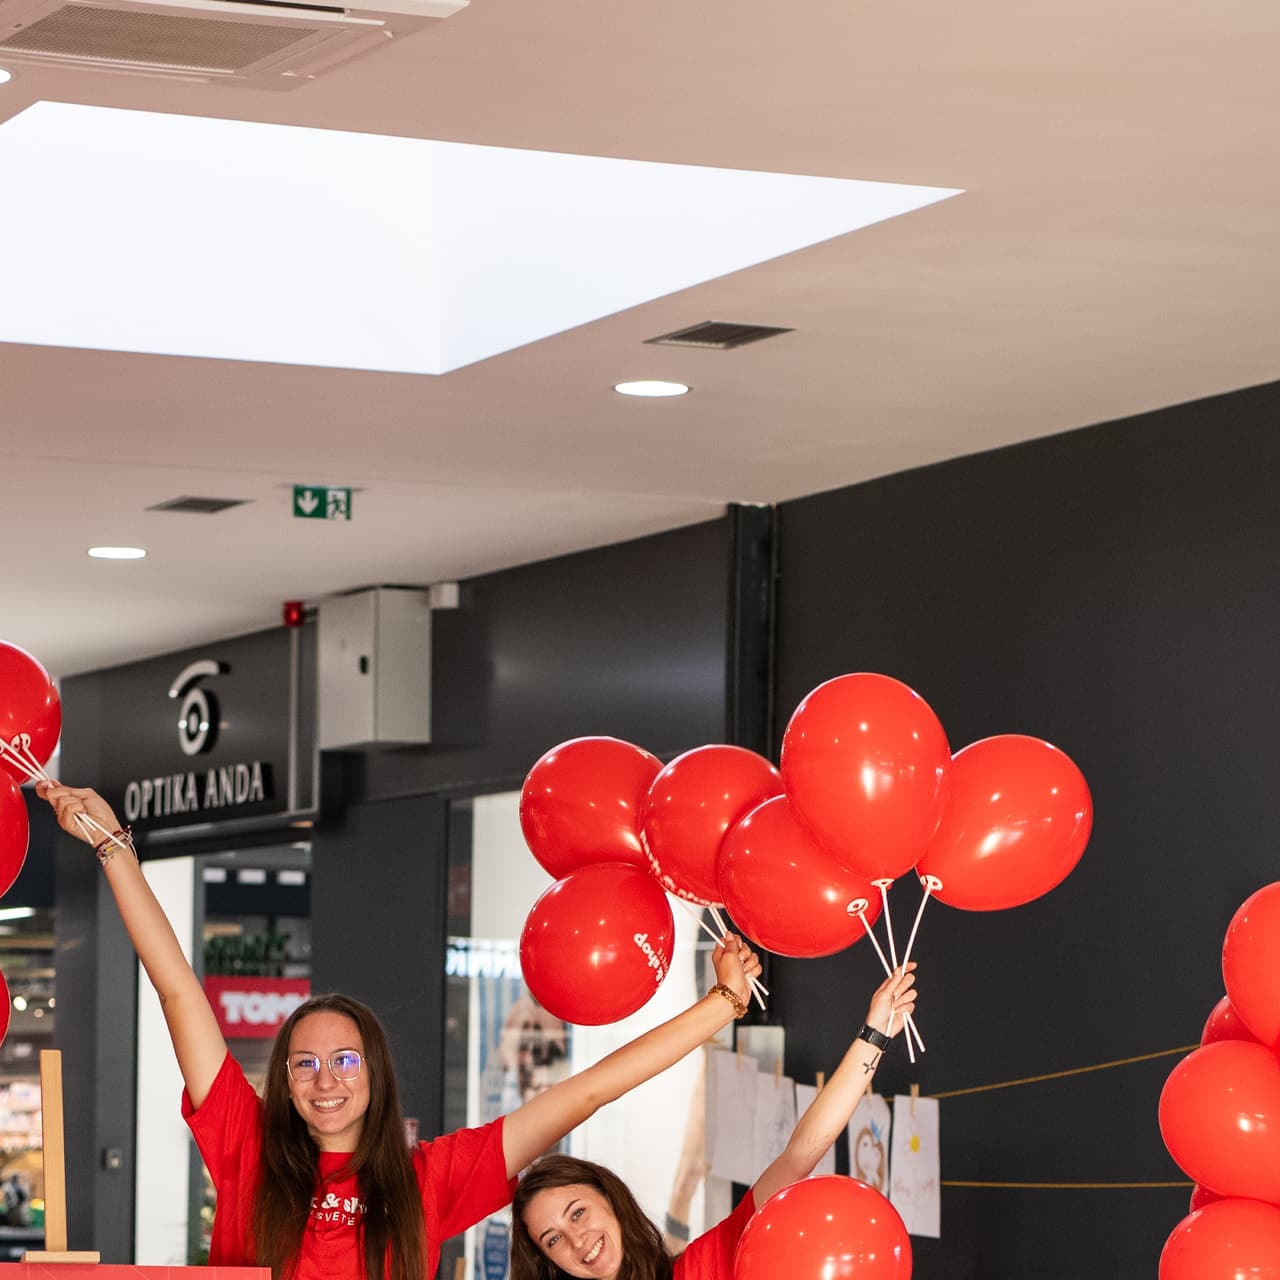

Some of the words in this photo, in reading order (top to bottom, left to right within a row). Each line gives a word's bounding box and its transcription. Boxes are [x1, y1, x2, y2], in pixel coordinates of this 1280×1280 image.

[124, 771, 198, 822] OPTIKA
[203, 760, 264, 809] ANDA
[633, 933, 660, 969] shop
[321, 1193, 342, 1209] &
